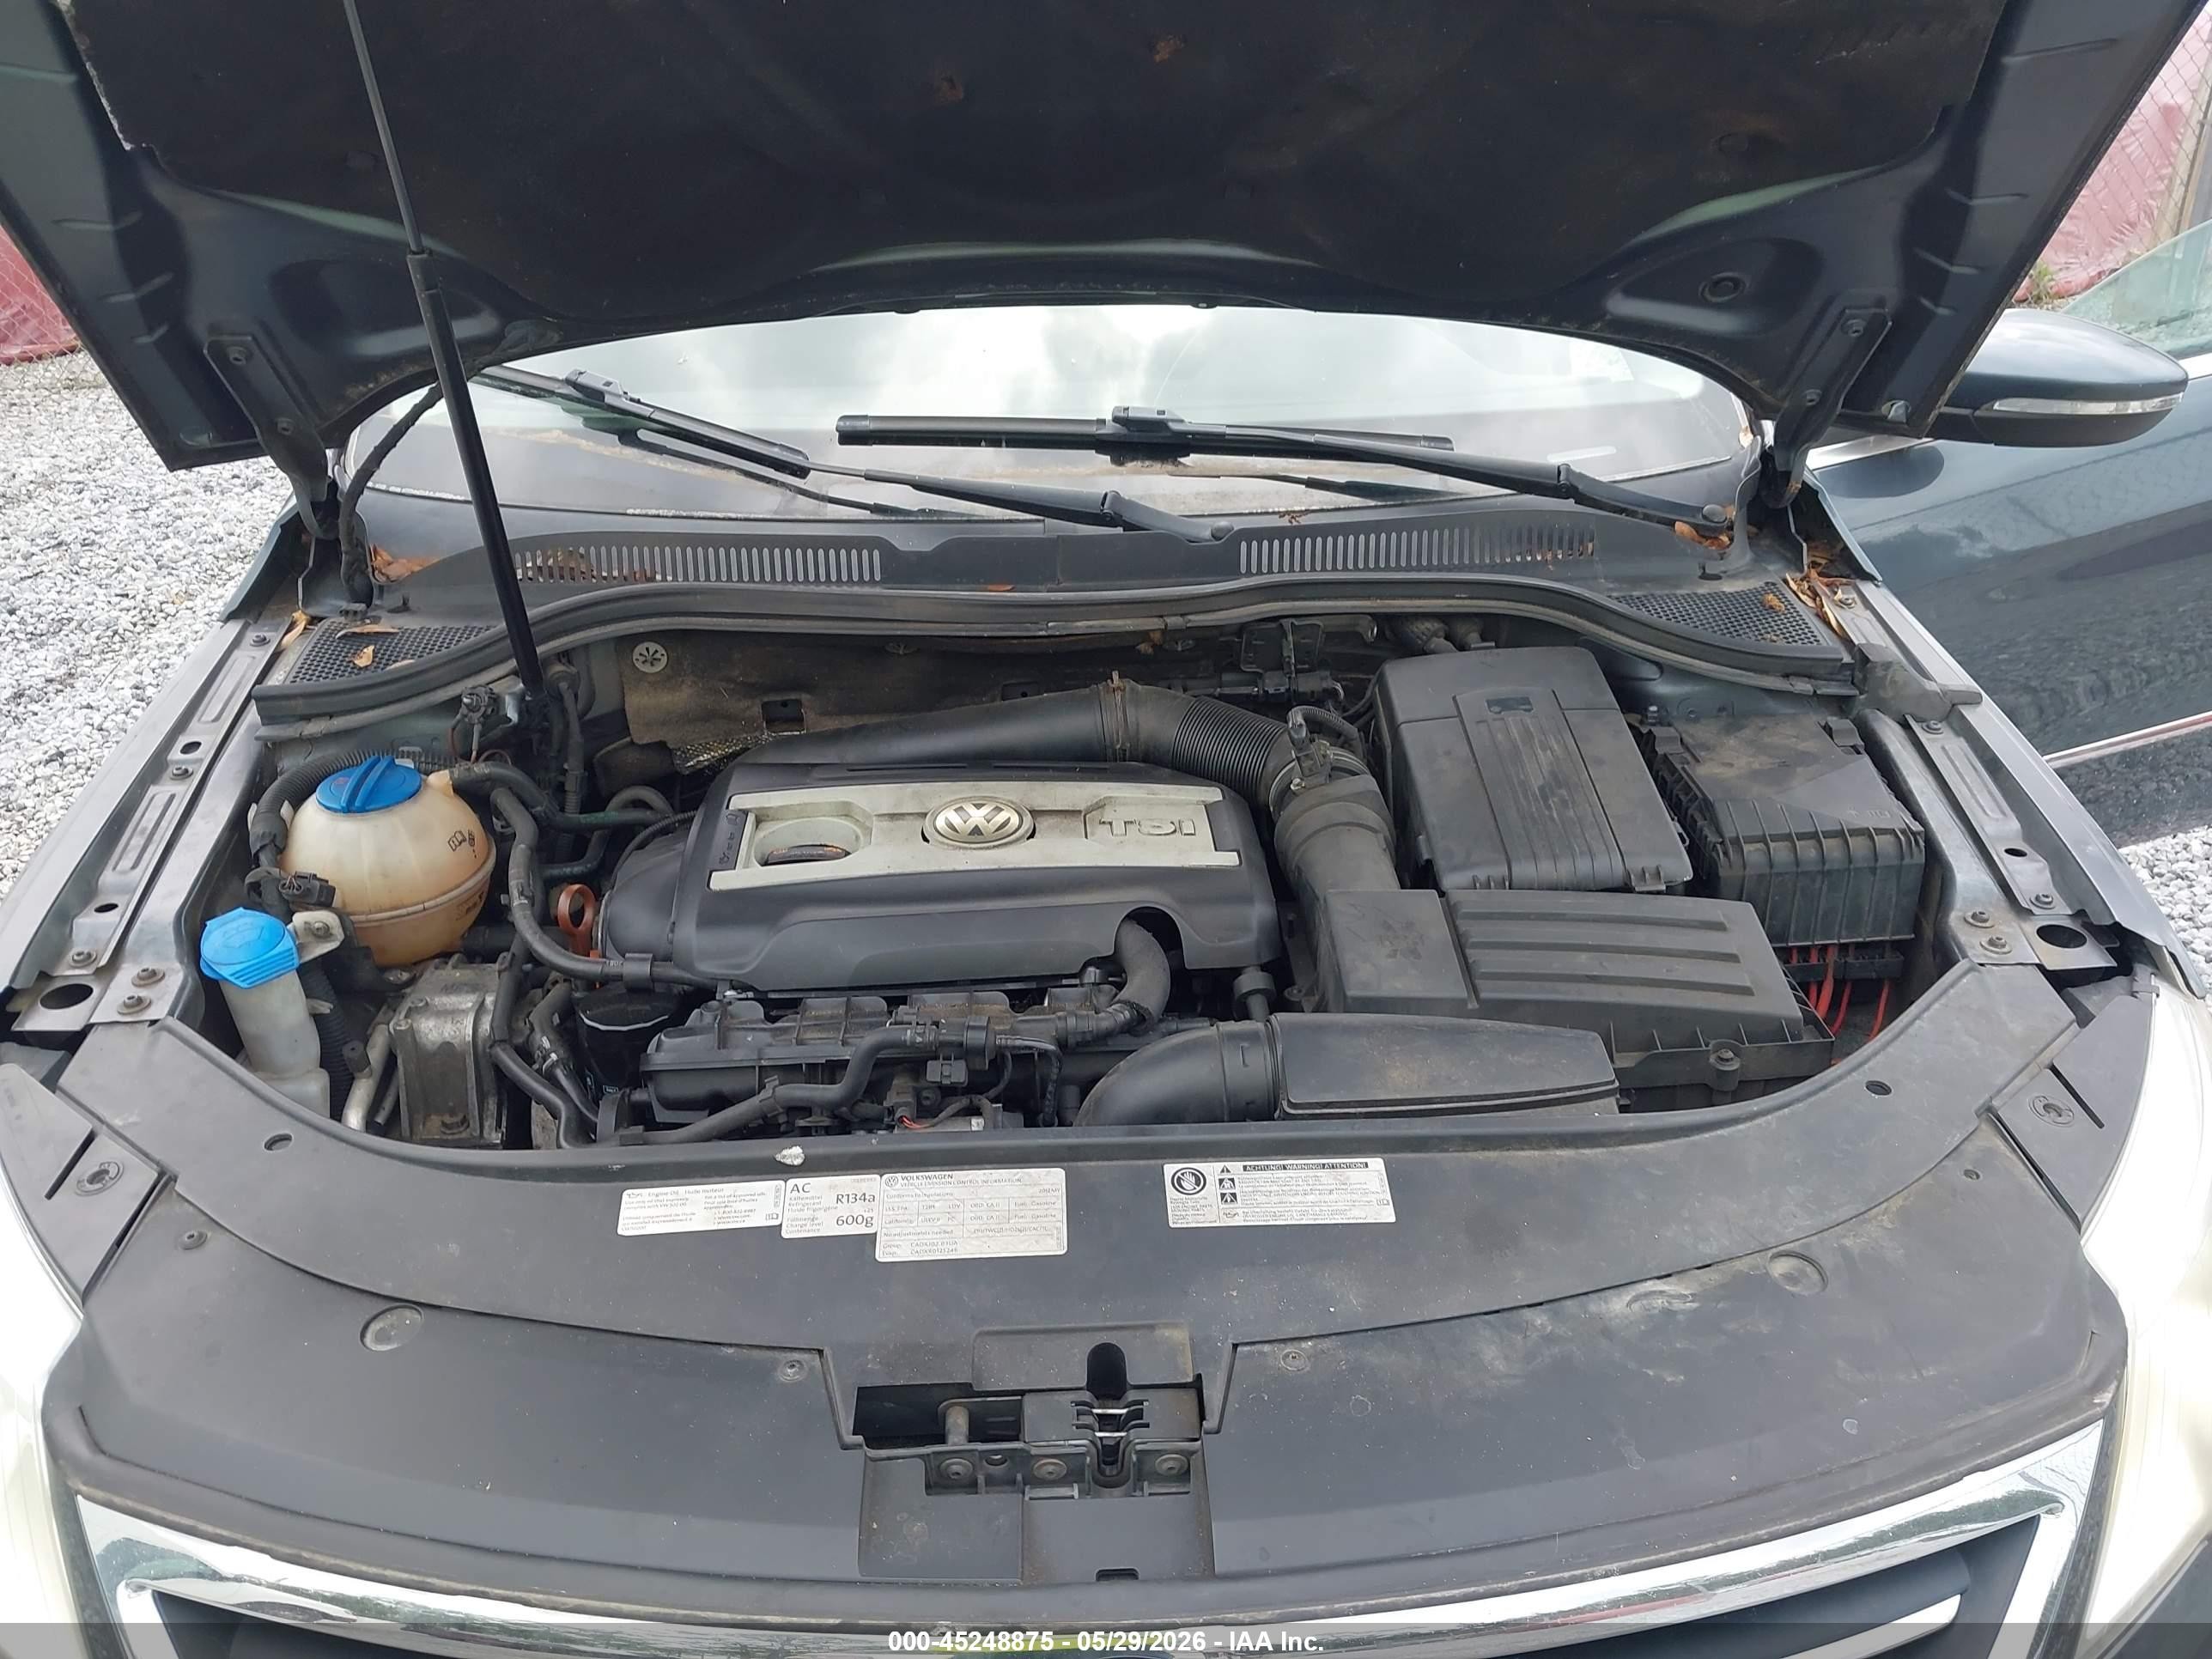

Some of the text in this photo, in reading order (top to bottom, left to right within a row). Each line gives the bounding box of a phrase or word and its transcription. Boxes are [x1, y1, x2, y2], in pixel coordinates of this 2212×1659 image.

[1099, 817, 1196, 836] TSI
[790, 1182, 811, 1194] AC
[836, 1193, 875, 1204] R134a
[836, 1214, 874, 1228] 600g
